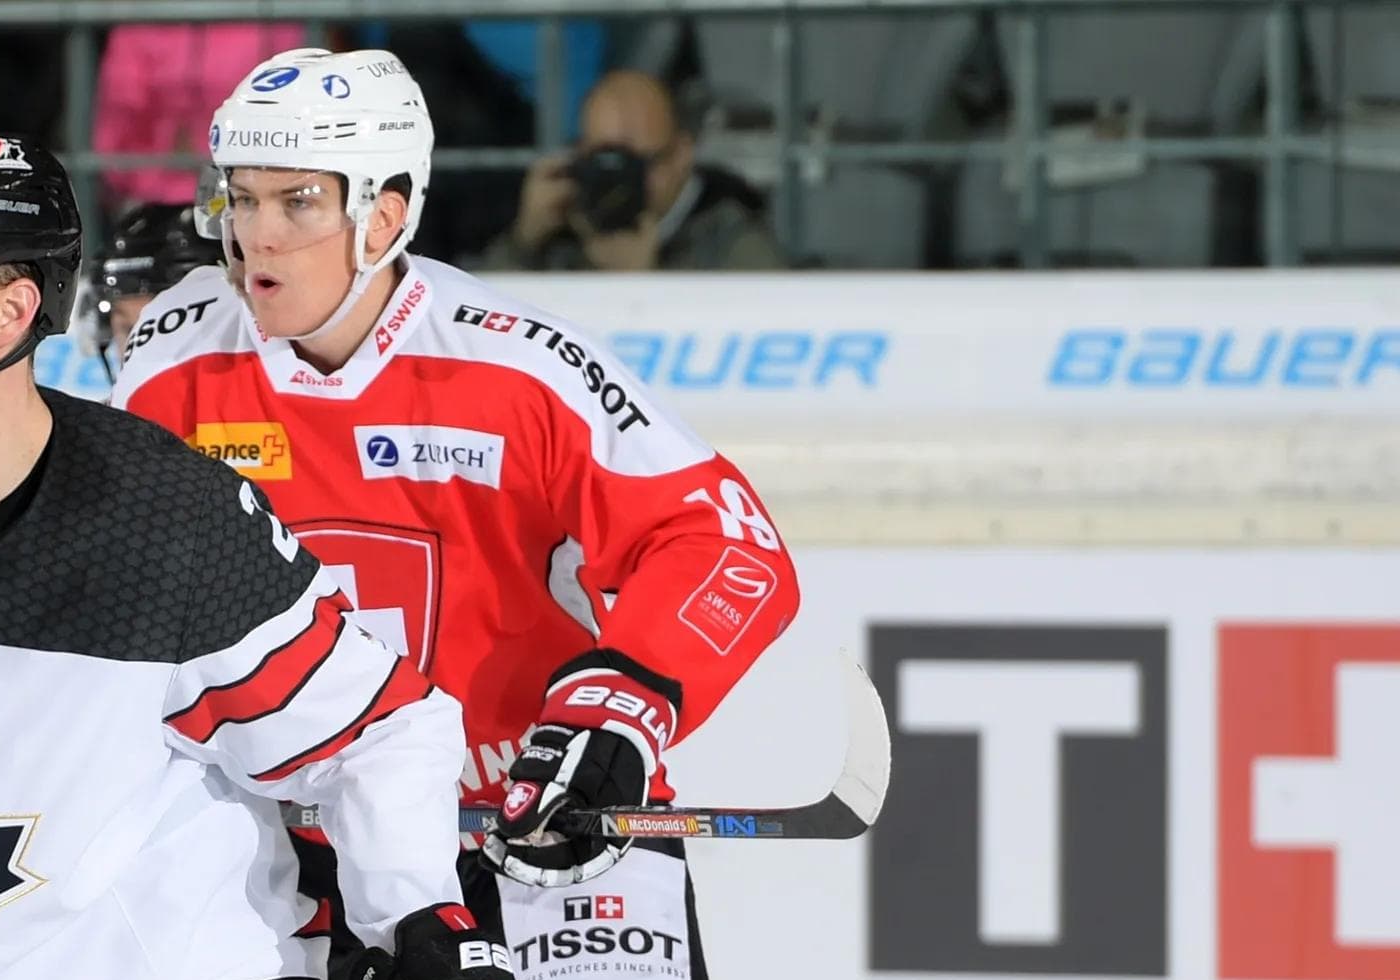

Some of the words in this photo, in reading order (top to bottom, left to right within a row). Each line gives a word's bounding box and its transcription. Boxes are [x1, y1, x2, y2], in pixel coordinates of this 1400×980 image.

[227, 131, 299, 148] ZURICH
[388, 280, 426, 331] SWISS
[523, 318, 651, 433] TISSOT
[703, 591, 743, 625] SWISS
[512, 926, 683, 972] TISSOT
[549, 962, 608, 978] WATCHES
[615, 963, 653, 973] SINCE
